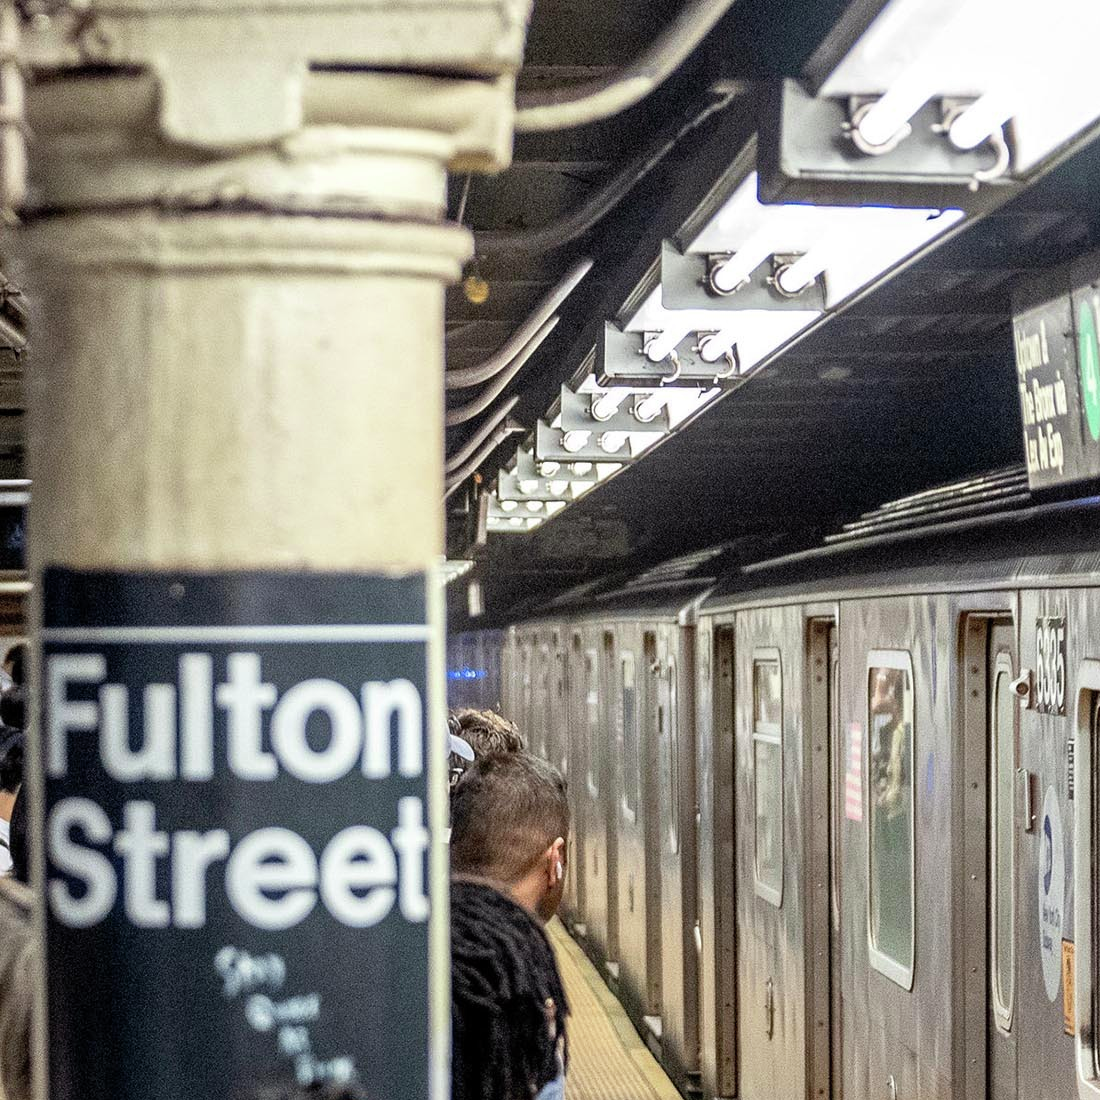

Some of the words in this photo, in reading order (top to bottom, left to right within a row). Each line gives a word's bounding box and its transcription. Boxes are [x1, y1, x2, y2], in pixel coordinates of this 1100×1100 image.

[1086, 332, 1099, 407] 4
[47, 652, 426, 784] Fulton
[1036, 626, 1065, 708] 6335
[47, 796, 432, 931] Street
